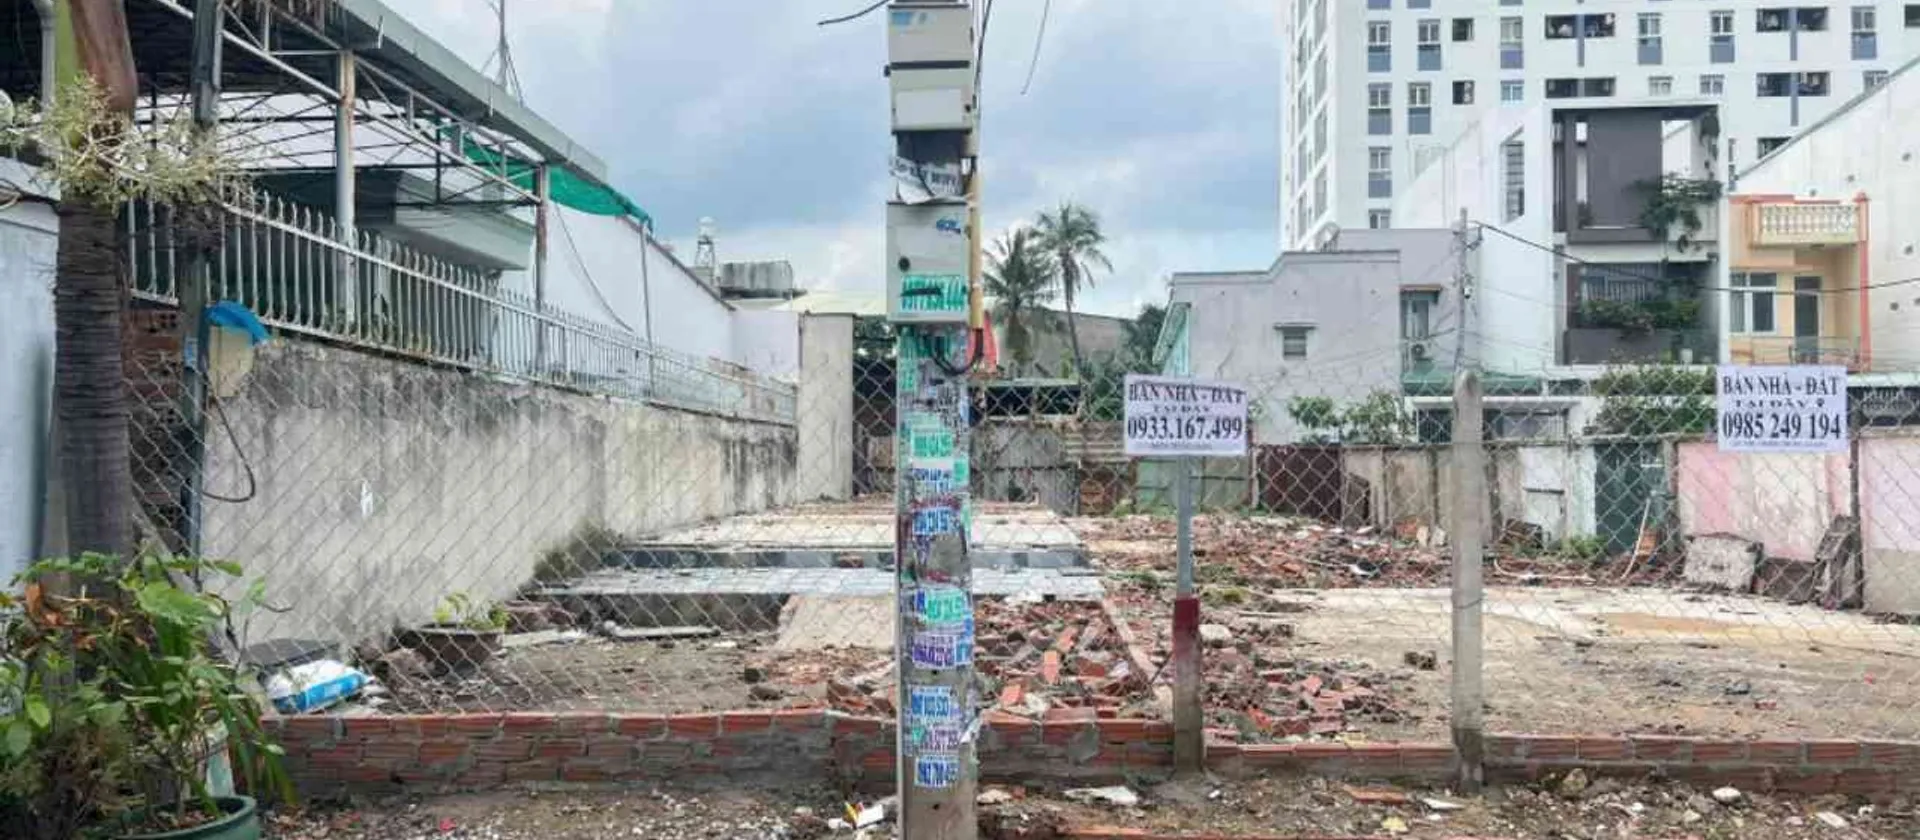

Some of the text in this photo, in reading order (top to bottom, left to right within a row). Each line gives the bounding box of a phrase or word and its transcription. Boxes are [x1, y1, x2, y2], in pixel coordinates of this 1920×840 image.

[1127, 416, 1243, 439] 0933.167.499
[1722, 412, 1841, 439] 0985 249 194
